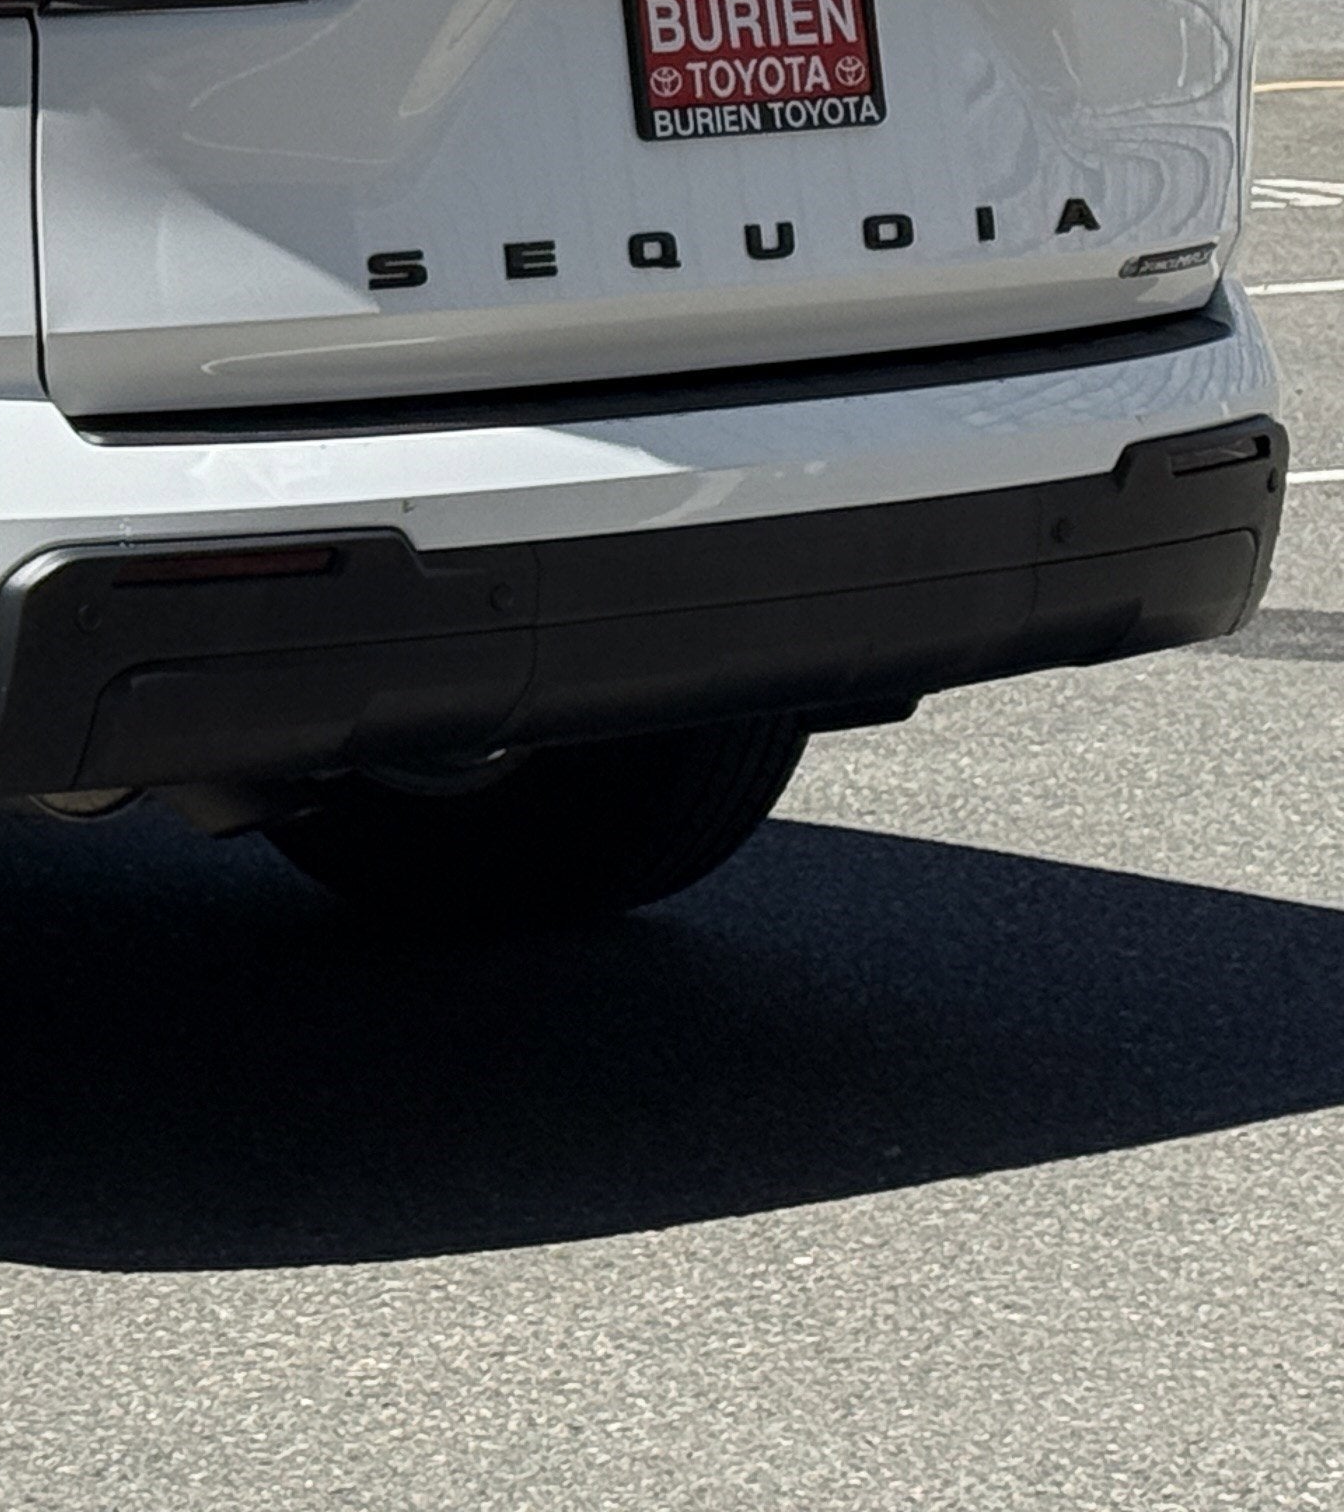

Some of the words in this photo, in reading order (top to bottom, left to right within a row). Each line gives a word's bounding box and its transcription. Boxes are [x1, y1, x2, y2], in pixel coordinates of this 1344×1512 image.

[685, 55, 832, 99] TOYOTA
[653, 103, 762, 138] BURIEN
[767, 95, 880, 130] TOYOTA
[367, 197, 1101, 289] SEQUOIA
